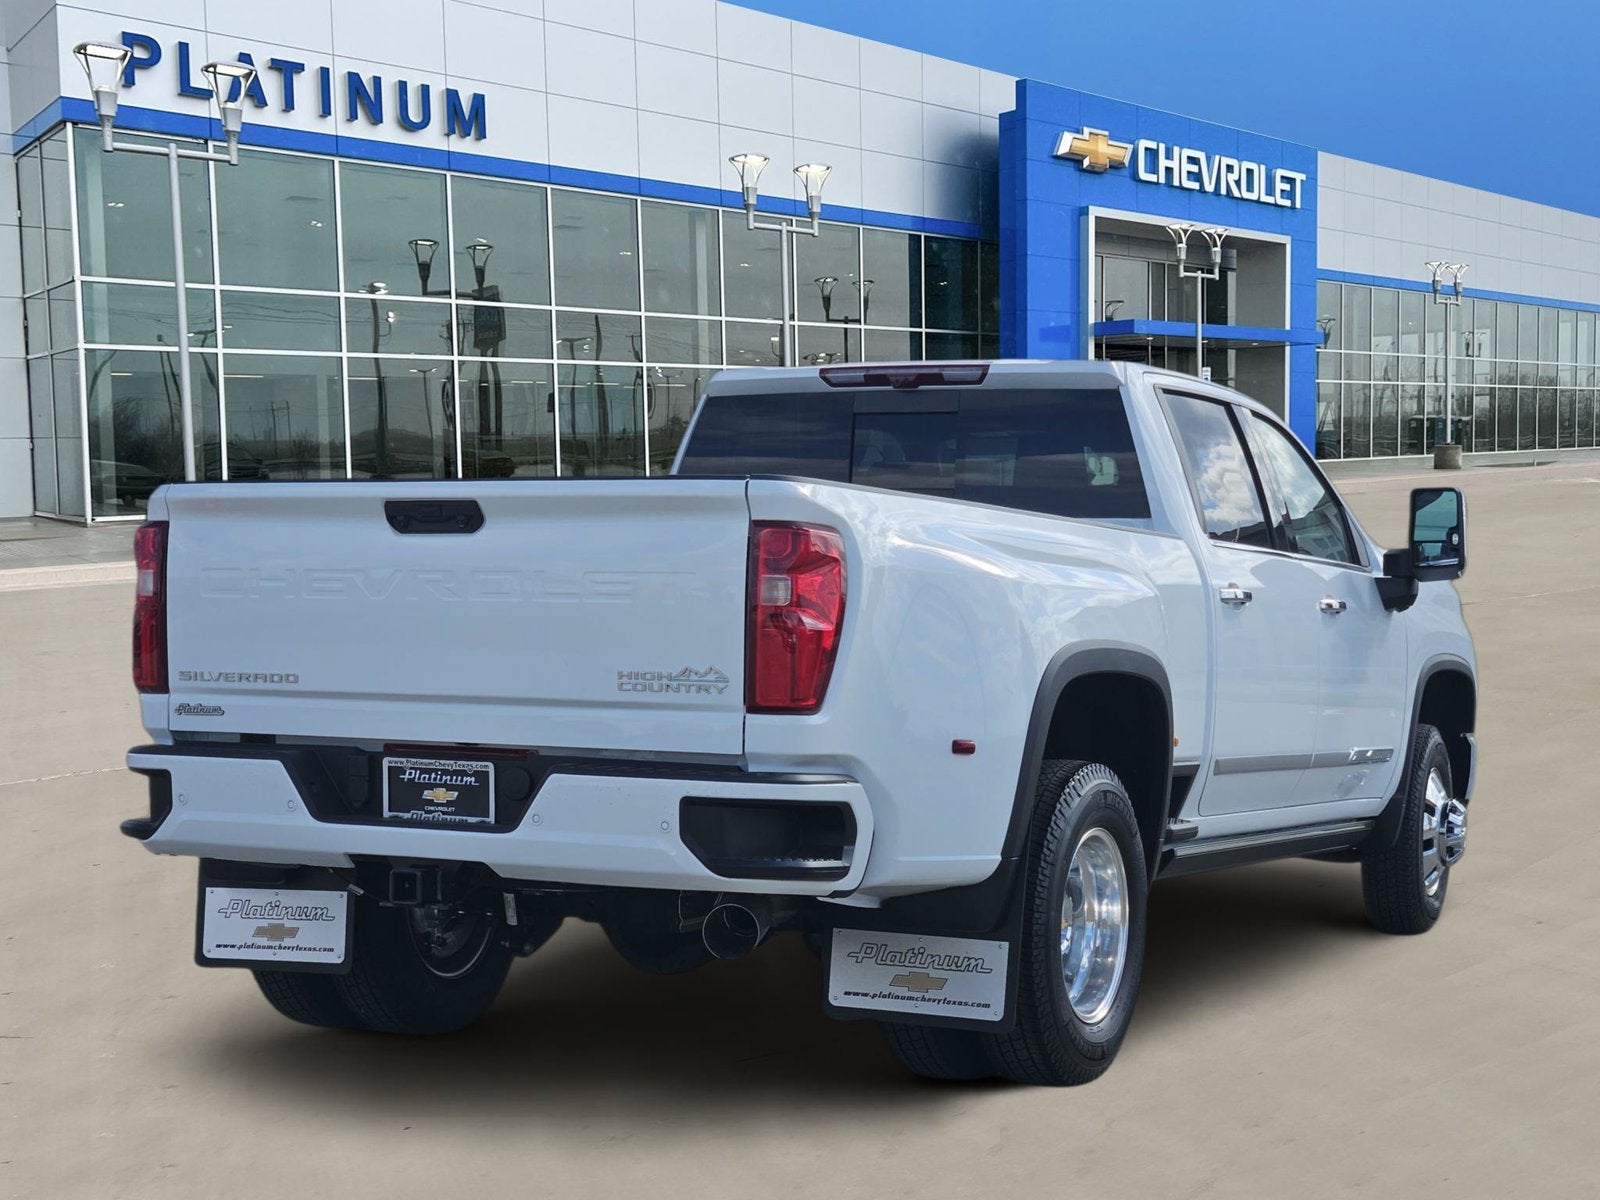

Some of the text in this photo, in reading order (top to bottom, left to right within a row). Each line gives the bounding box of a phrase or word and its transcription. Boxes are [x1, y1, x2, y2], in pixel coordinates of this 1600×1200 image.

[120, 31, 487, 141] PLATINUM
[1137, 138, 1307, 209] CHEVROLET
[178, 670, 299, 684] SILVERADO
[617, 670, 673, 681] HIGH
[617, 681, 729, 694] COUNTRY
[174, 702, 225, 716] Platinum
[399, 769, 480, 786] Platinum
[217, 899, 336, 921] Platinum
[215, 942, 335, 953] www.platinumchevytexas.com
[847, 942, 993, 974] Platinum
[843, 990, 991, 1009] www.platinumchevytexas.com
